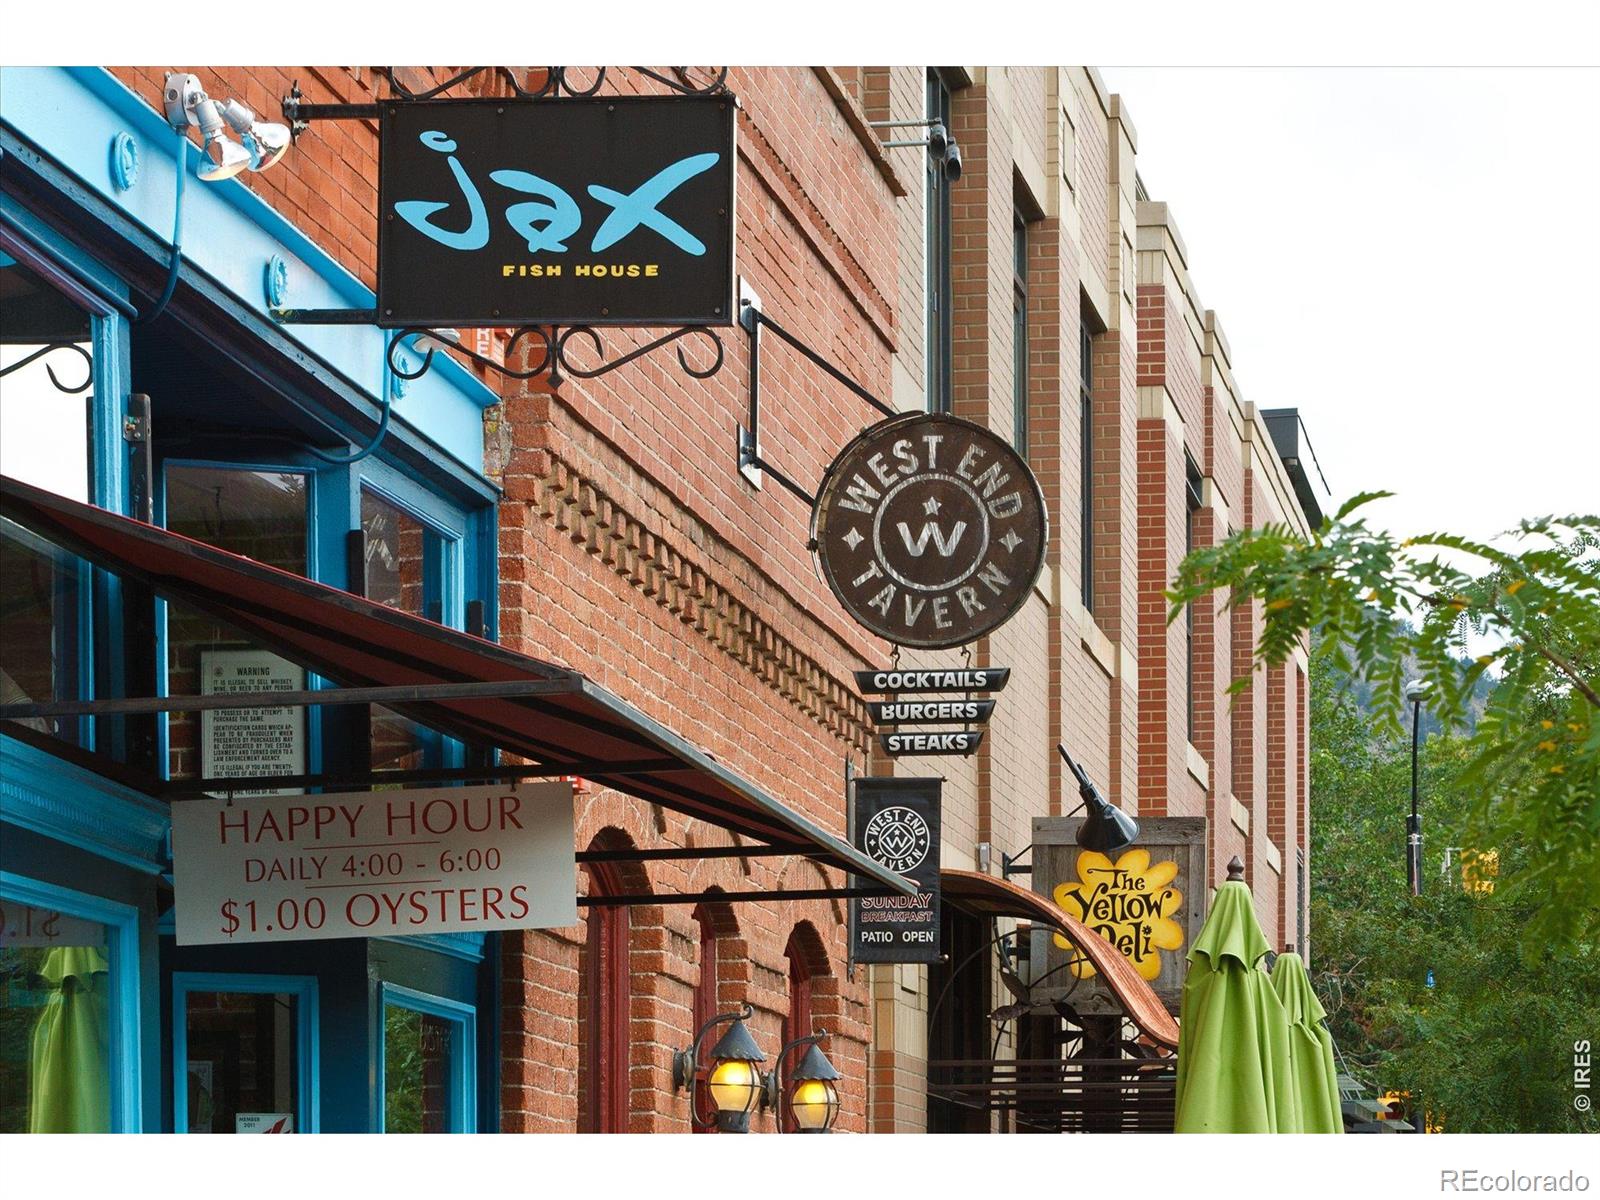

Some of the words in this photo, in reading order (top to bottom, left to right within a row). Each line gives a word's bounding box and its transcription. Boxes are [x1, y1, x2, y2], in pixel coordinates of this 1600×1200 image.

[394, 130, 720, 256] jax
[502, 264, 562, 278] FISH
[575, 264, 660, 278] HOUSE
[838, 435, 944, 514] WEST
[955, 443, 1023, 519] END
[852, 559, 1012, 629] TAVERN
[237, 667, 270, 675] WARNING
[873, 671, 987, 688] COCKTAILS
[881, 703, 978, 720] BURGERS
[888, 734, 968, 751] STEAKS
[219, 804, 364, 845] HAPPY
[386, 796, 524, 837] HOUR
[868, 809, 901, 837] WEST
[903, 812, 926, 836] END
[245, 855, 329, 883] DAILY
[341, 852, 402, 878] 4:00
[439, 847, 501, 874] 6:00
[871, 848, 923, 871] TAVERN
[1086, 868, 1146, 891] The
[220, 897, 326, 939] $1.00
[345, 885, 530, 928] OYSTERS
[861, 893, 933, 909] SUNDAY
[1063, 882, 1173, 924] Yellow
[861, 911, 933, 923] BREAKFAST
[861, 931, 894, 943] PATIO
[902, 931, 934, 943] OPEN
